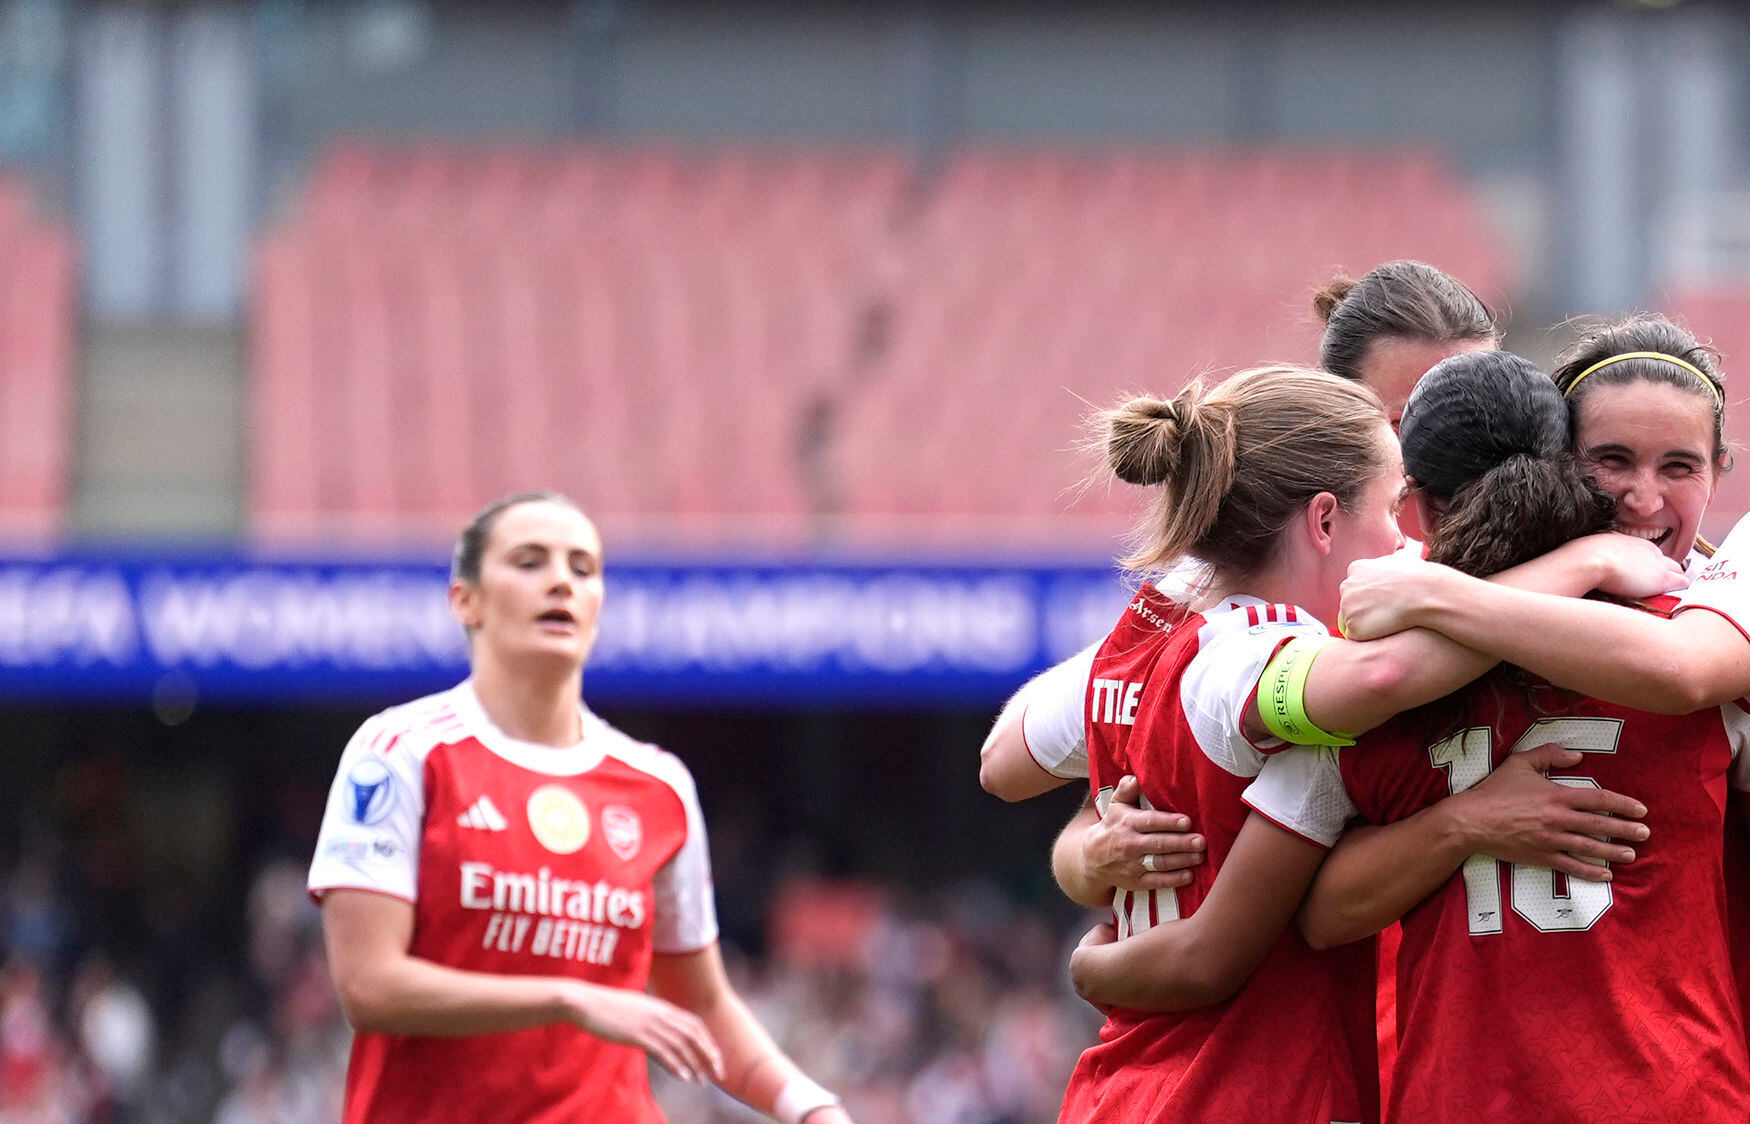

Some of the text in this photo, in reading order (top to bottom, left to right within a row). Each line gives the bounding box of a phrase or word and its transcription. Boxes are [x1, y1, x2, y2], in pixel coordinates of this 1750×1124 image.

[1428, 716, 1625, 936] 16
[459, 861, 646, 930] Emirates
[481, 914, 620, 966] FLY BETTER
